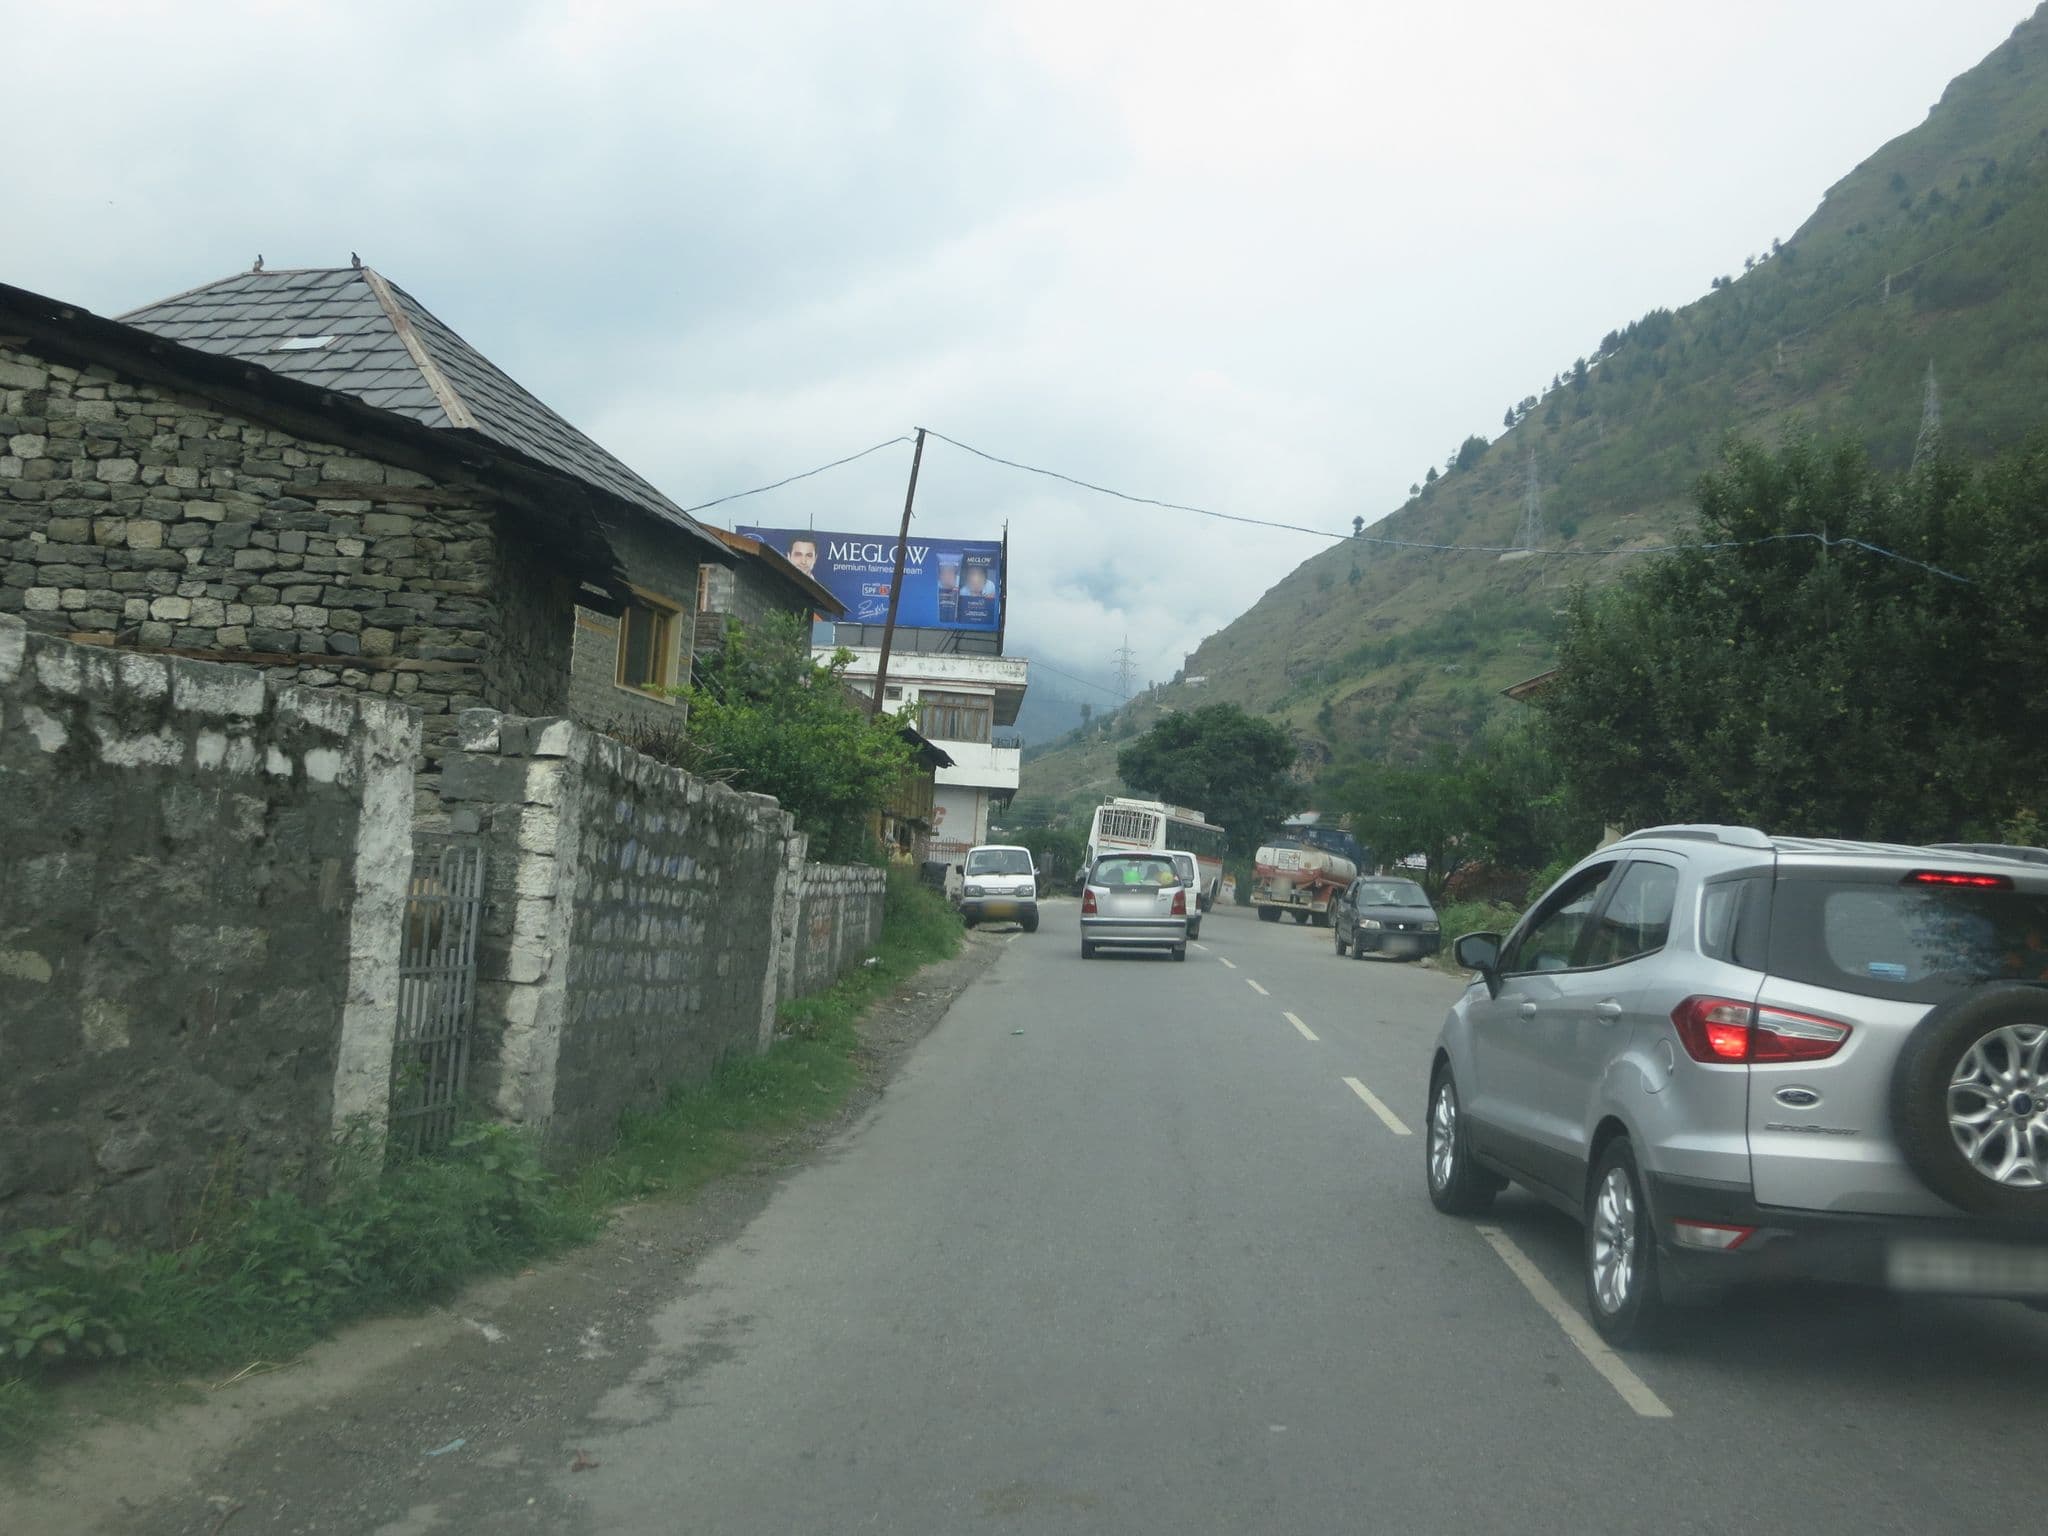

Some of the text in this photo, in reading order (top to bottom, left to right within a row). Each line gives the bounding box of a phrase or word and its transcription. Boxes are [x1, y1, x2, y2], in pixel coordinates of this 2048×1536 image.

[827, 540, 930, 565] MEGLOW
[833, 563, 867, 572] premium
[903, 567, 923, 575] ream
